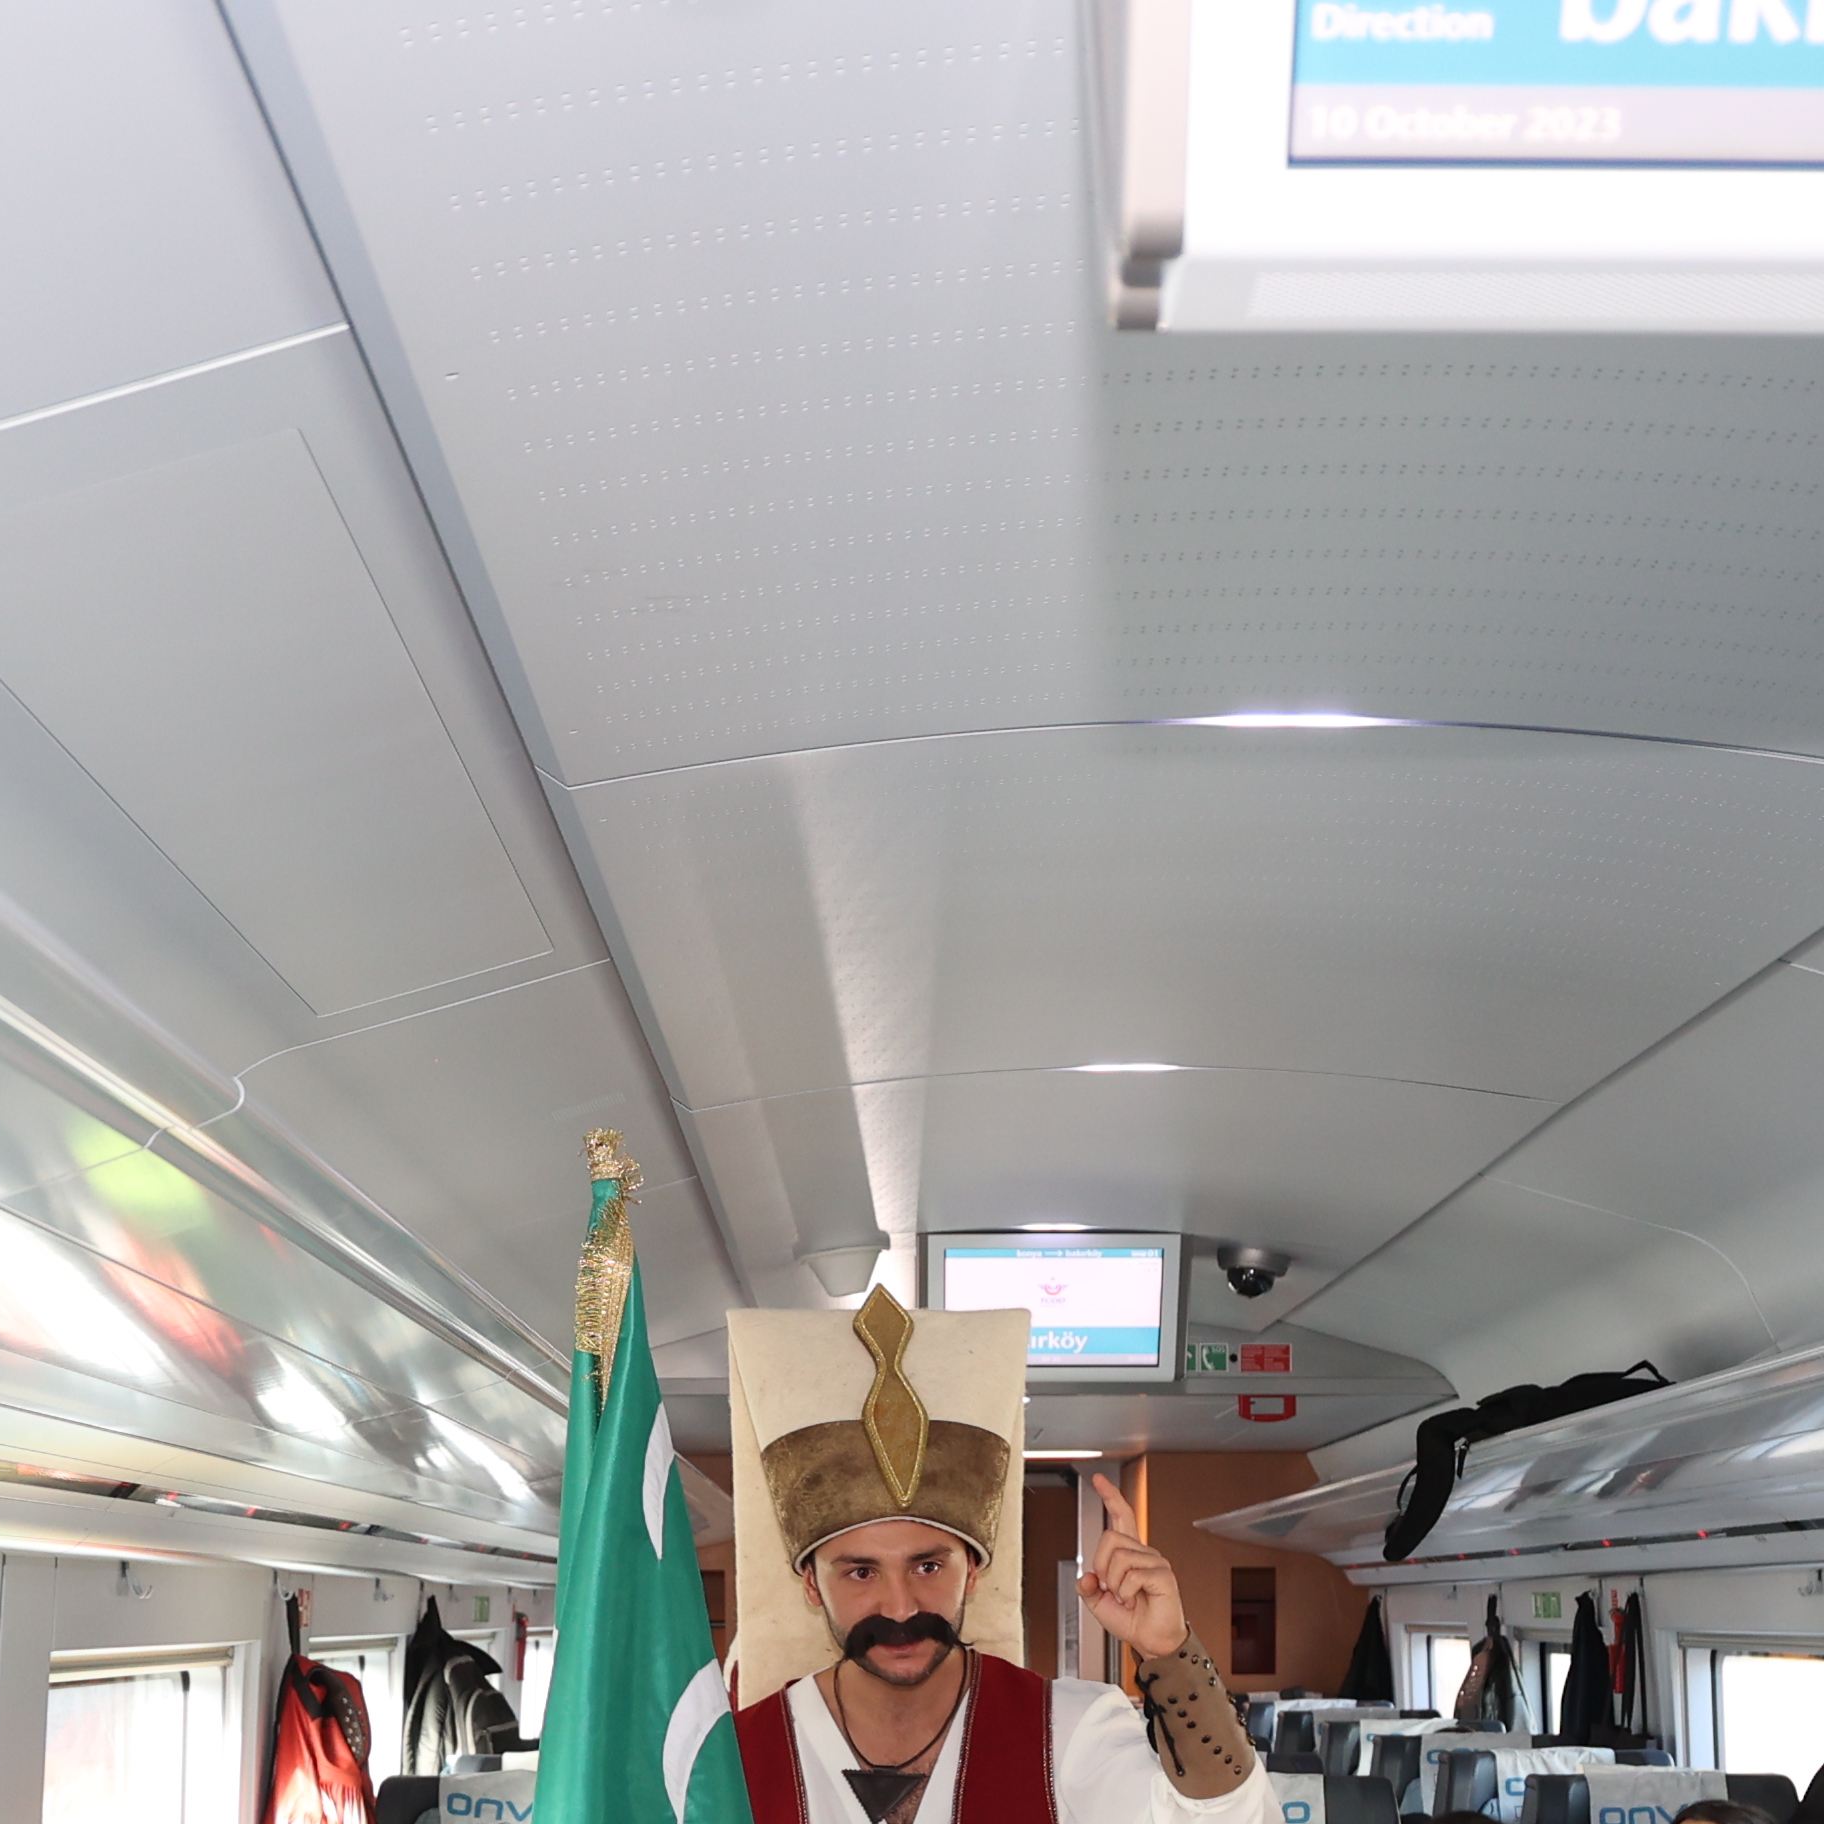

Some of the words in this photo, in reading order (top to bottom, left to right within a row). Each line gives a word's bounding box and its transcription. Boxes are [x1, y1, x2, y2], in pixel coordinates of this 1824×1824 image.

[1312, 3, 1491, 39] Direction
[1364, 104, 1518, 141] October
[1523, 106, 1622, 142] 2023
[1027, 1331, 1088, 1353] ırköy
[447, 1792, 533, 1822] onv
